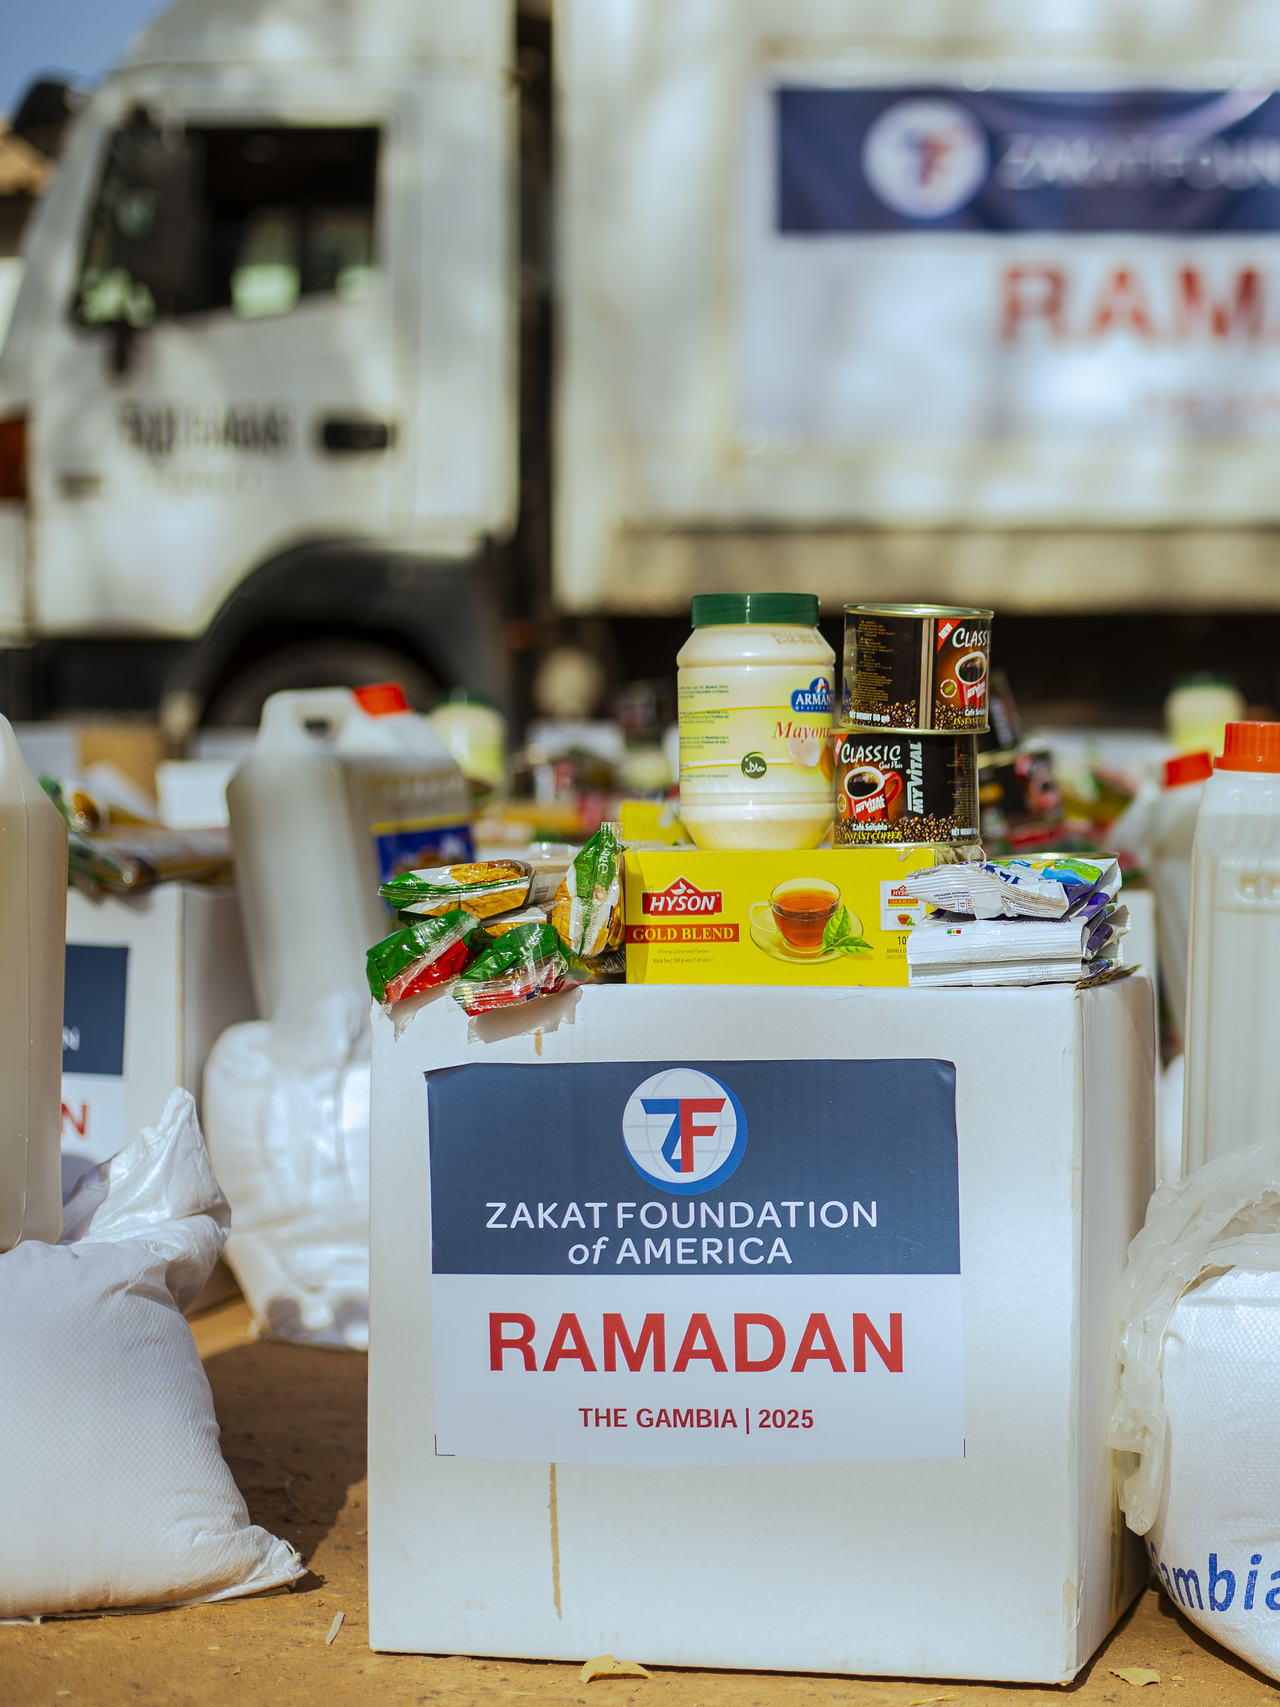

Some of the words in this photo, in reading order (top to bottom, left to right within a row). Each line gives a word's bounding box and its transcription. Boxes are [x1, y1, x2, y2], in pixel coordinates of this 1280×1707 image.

[841, 743, 901, 763] CLASSIC
[871, 831, 903, 840] COFFEE
[649, 895, 716, 911] HYSON
[632, 928, 678, 941] GOLD
[681, 927, 734, 940] BLEND
[485, 1202, 607, 1230] ZAKAT
[616, 1201, 878, 1229] FOUNDATION
[568, 1237, 607, 1265] of
[615, 1237, 792, 1265] AMERICA
[488, 1312, 904, 1373] RAMADAN
[578, 1408, 630, 1429] THE
[635, 1407, 738, 1429] GAMBIA
[758, 1408, 814, 1429] 2025
